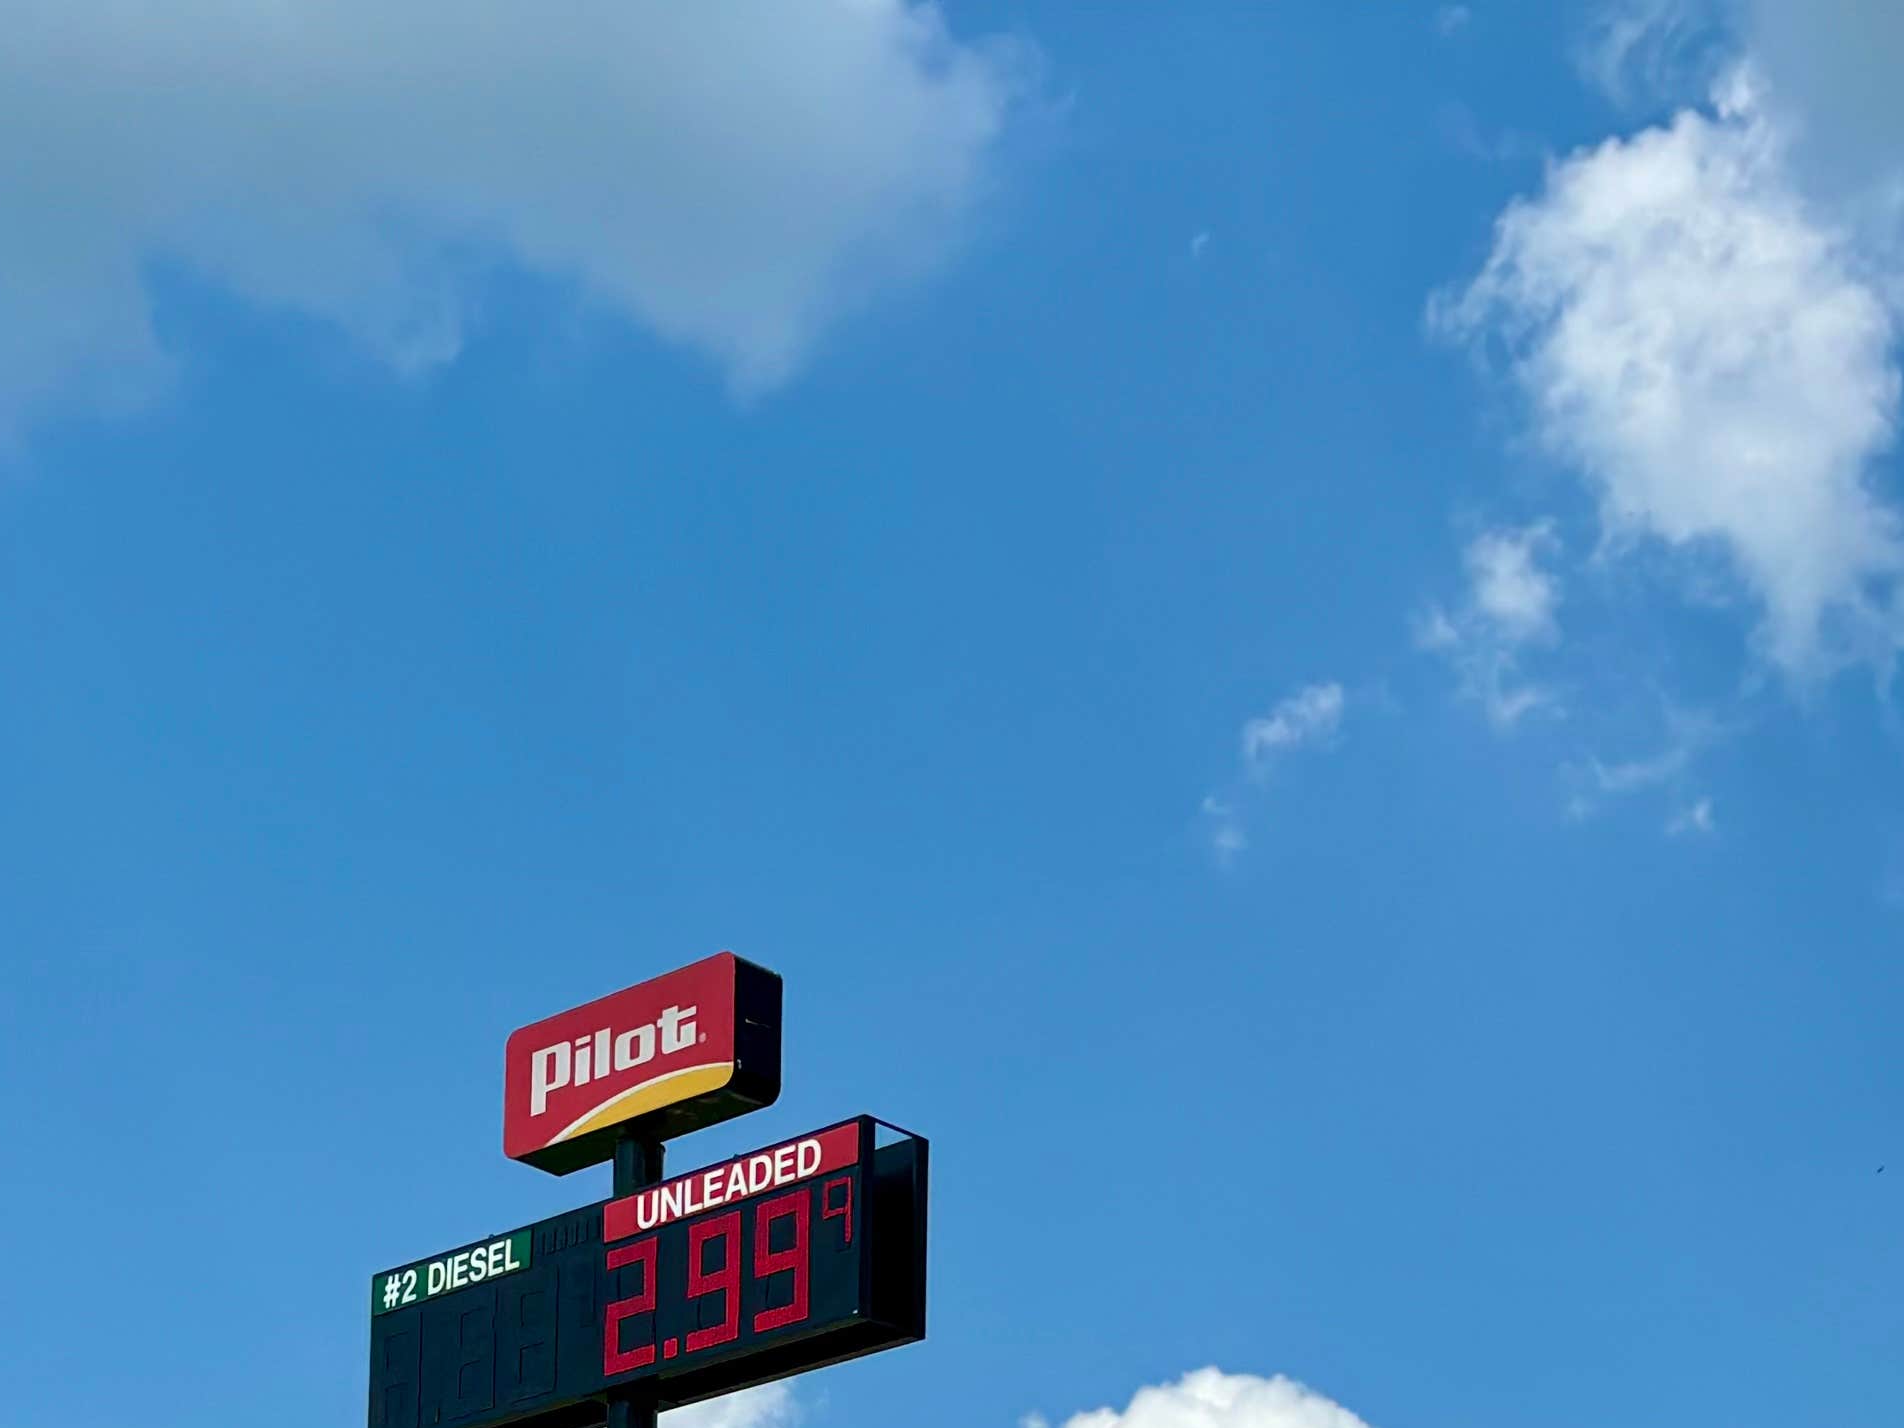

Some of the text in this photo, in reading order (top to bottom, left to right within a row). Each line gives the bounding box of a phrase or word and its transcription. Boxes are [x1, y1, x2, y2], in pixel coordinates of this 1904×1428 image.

[636, 1138, 821, 1230] UNLEADED
[383, 1238, 520, 1309] #2 DIESEL
